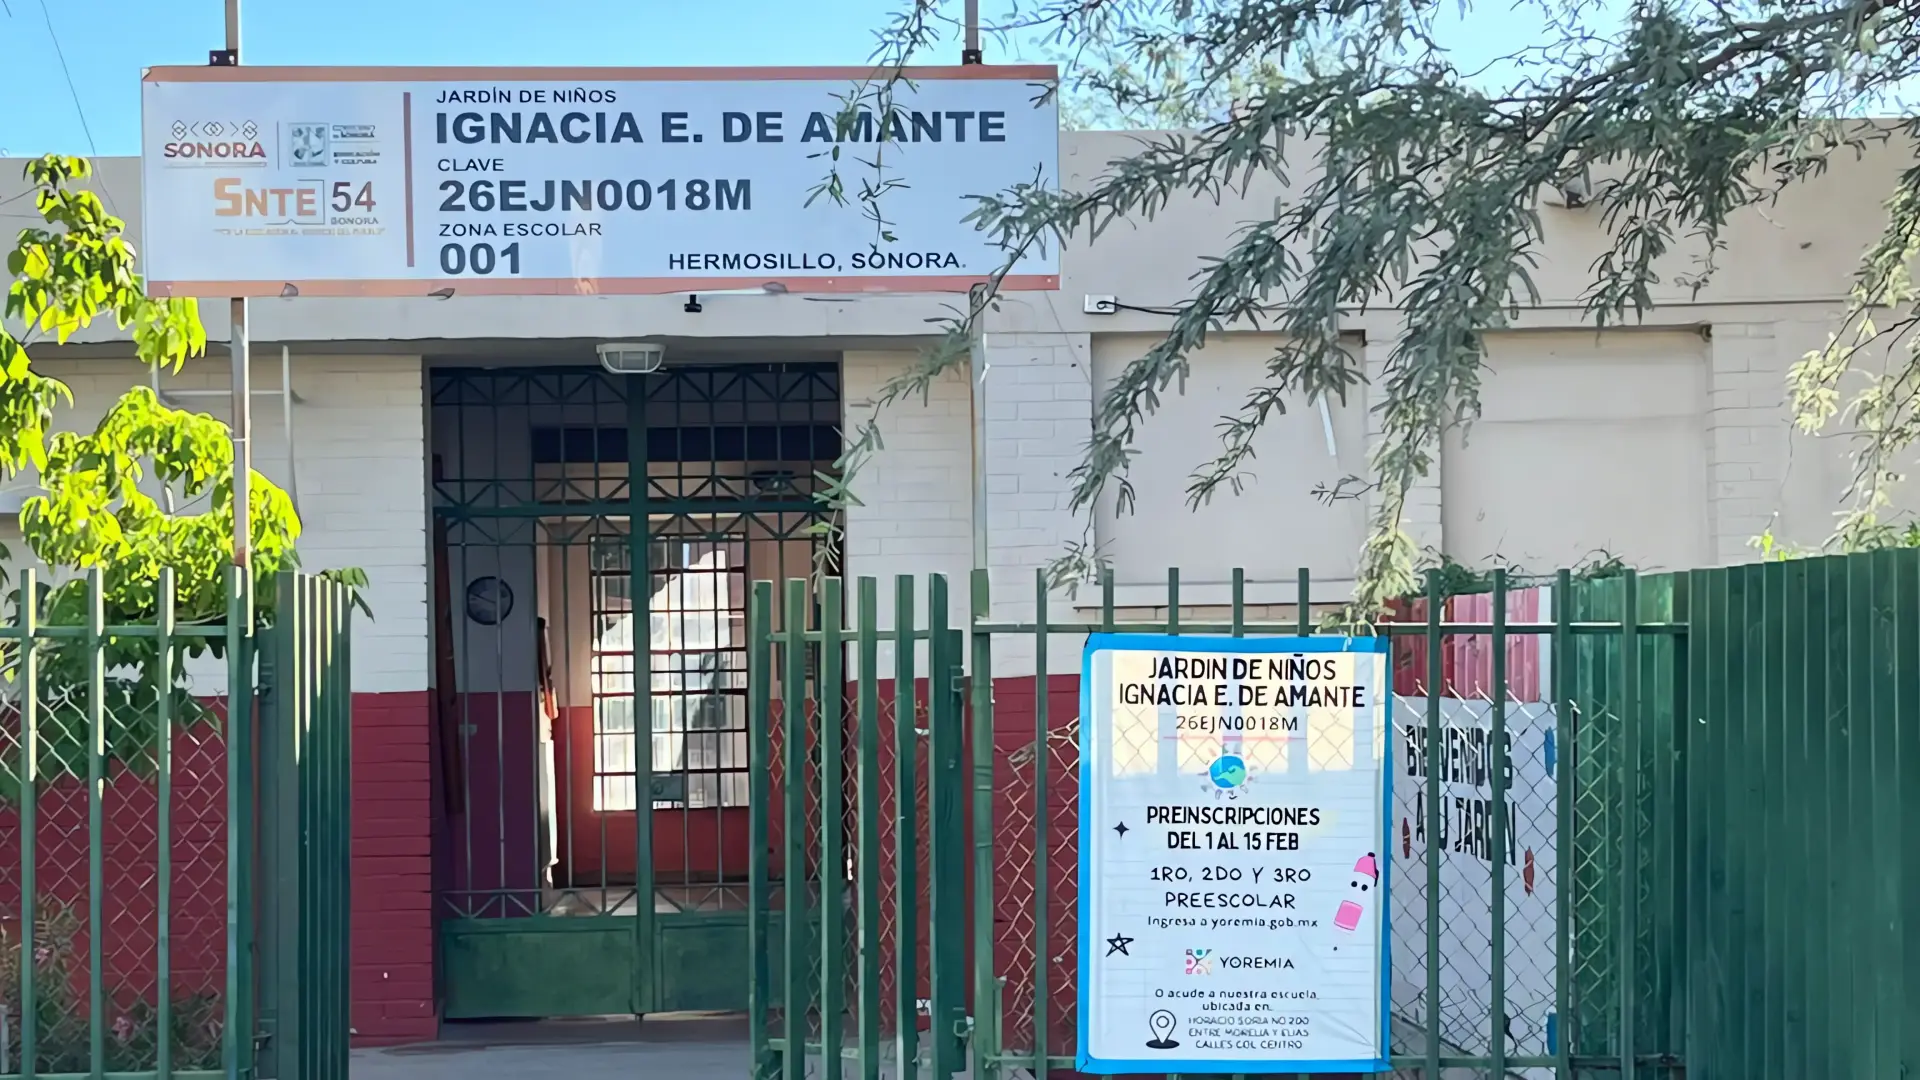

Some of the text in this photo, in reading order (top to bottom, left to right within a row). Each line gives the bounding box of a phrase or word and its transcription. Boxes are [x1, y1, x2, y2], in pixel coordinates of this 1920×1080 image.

[437, 87, 616, 103] JARDÍN DE NIÑOS
[437, 110, 1006, 144] IGNACIA E. DE AMANTE
[164, 142, 266, 157] SONORA
[438, 159, 503, 171] CLAVE
[214, 178, 377, 216] SNTE 54
[439, 179, 751, 211] 26EJN0018M
[439, 223, 601, 236] ZONA ESCOLAR
[440, 242, 519, 274] 001
[670, 253, 841, 271] HERMOSILLO,
[1149, 653, 1335, 680] JARDIN DE NIÑOS
[1120, 683, 1365, 707] IGNACIA E. DE AMANTE
[1176, 716, 1297, 733] 26EJN0018M
[1406, 725, 1512, 789] BIEVENIDS
[1147, 806, 1320, 825] PREINSCRIPCIONES
[1416, 791, 1426, 844] A
[1454, 797, 1516, 866] JARDN
[1168, 832, 1298, 850] DEL 1 AL 15 FEB
[1151, 866, 1310, 884] 1RO, 2DO Y 3RO
[1166, 892, 1295, 909] PREESCOLAR
[1148, 916, 1195, 928] Ingresa
[1220, 957, 1294, 969] YOREMIA
[1168, 989, 1204, 998] acude
[1203, 1002, 1250, 1011] ubicada
